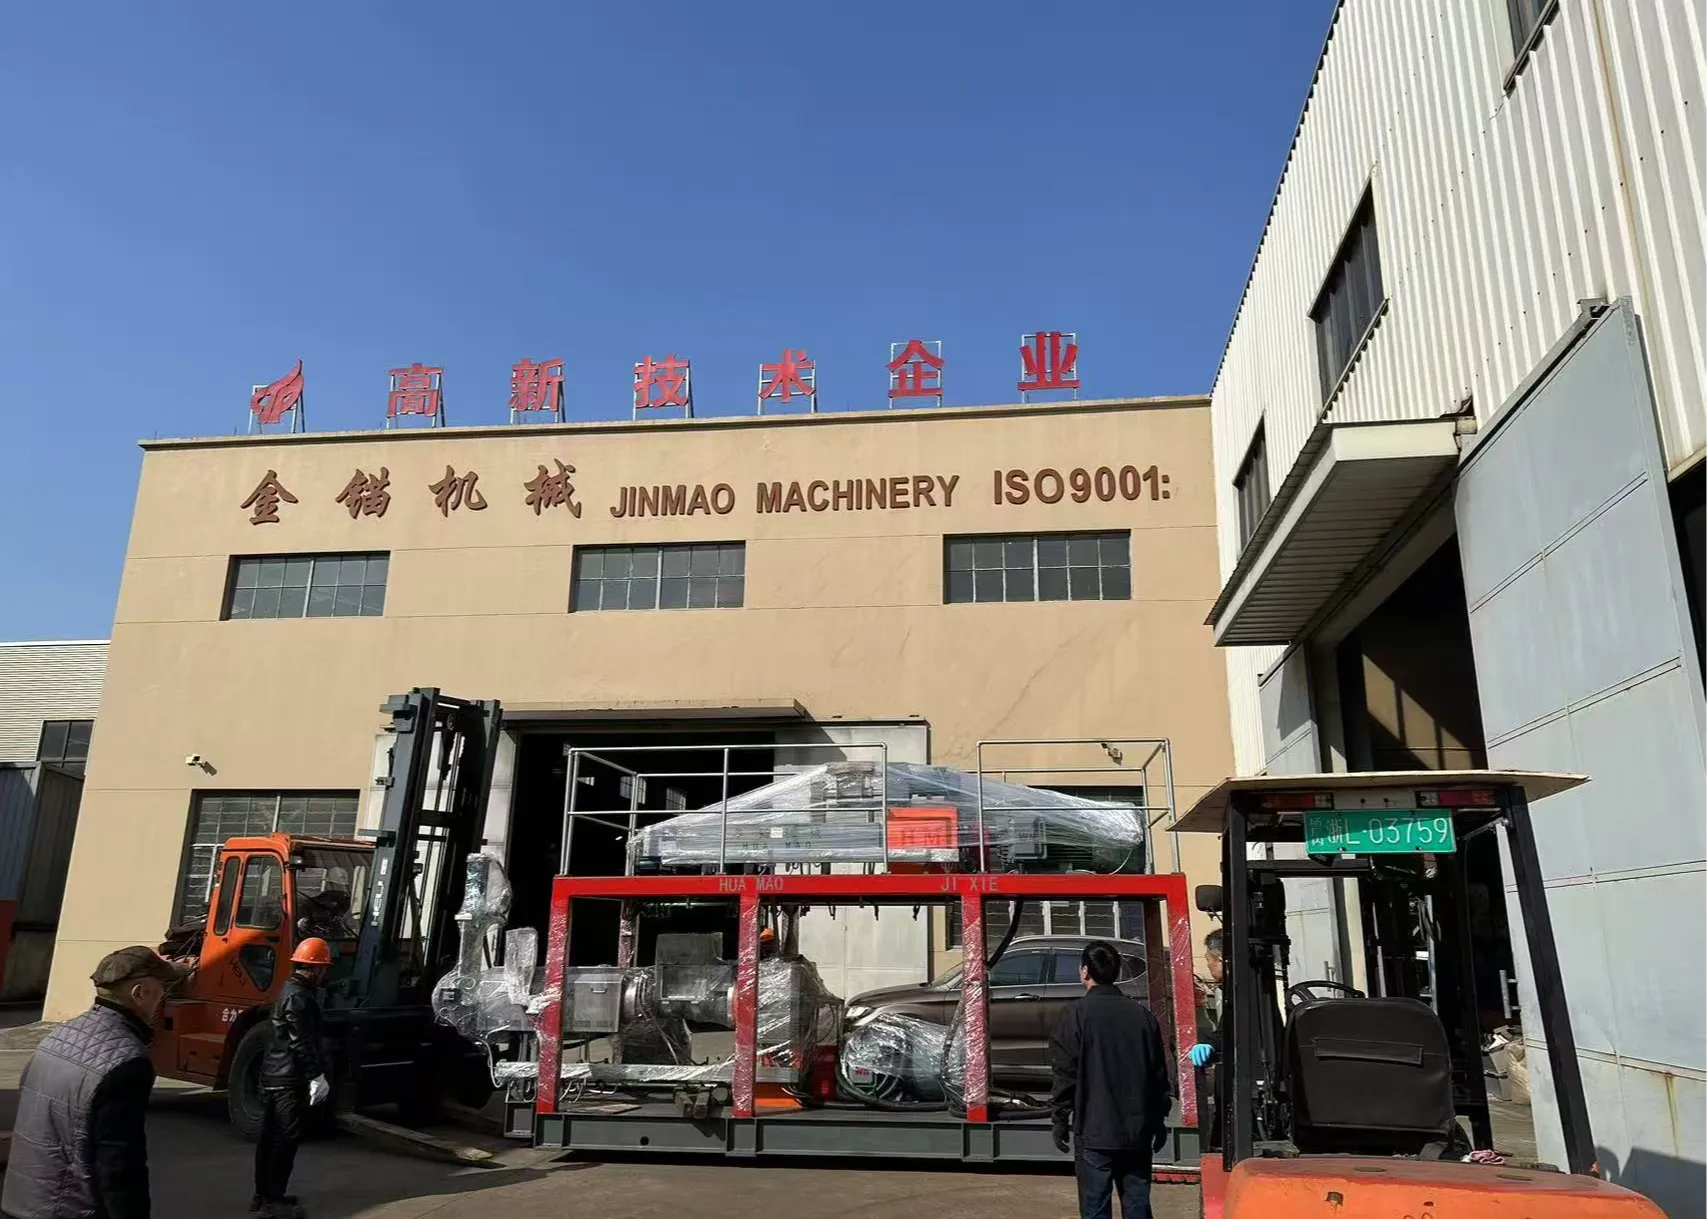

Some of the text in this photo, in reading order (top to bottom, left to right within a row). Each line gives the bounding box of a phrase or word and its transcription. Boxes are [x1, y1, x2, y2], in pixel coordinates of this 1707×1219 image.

[387, 331, 1081, 418] 高新技术企业
[240, 458, 1171, 526] 金锚机械 JINMAO MACHINERY ISO9001:
[719, 879, 784, 892] HUA MAO
[941, 879, 998, 892] JI XIE
